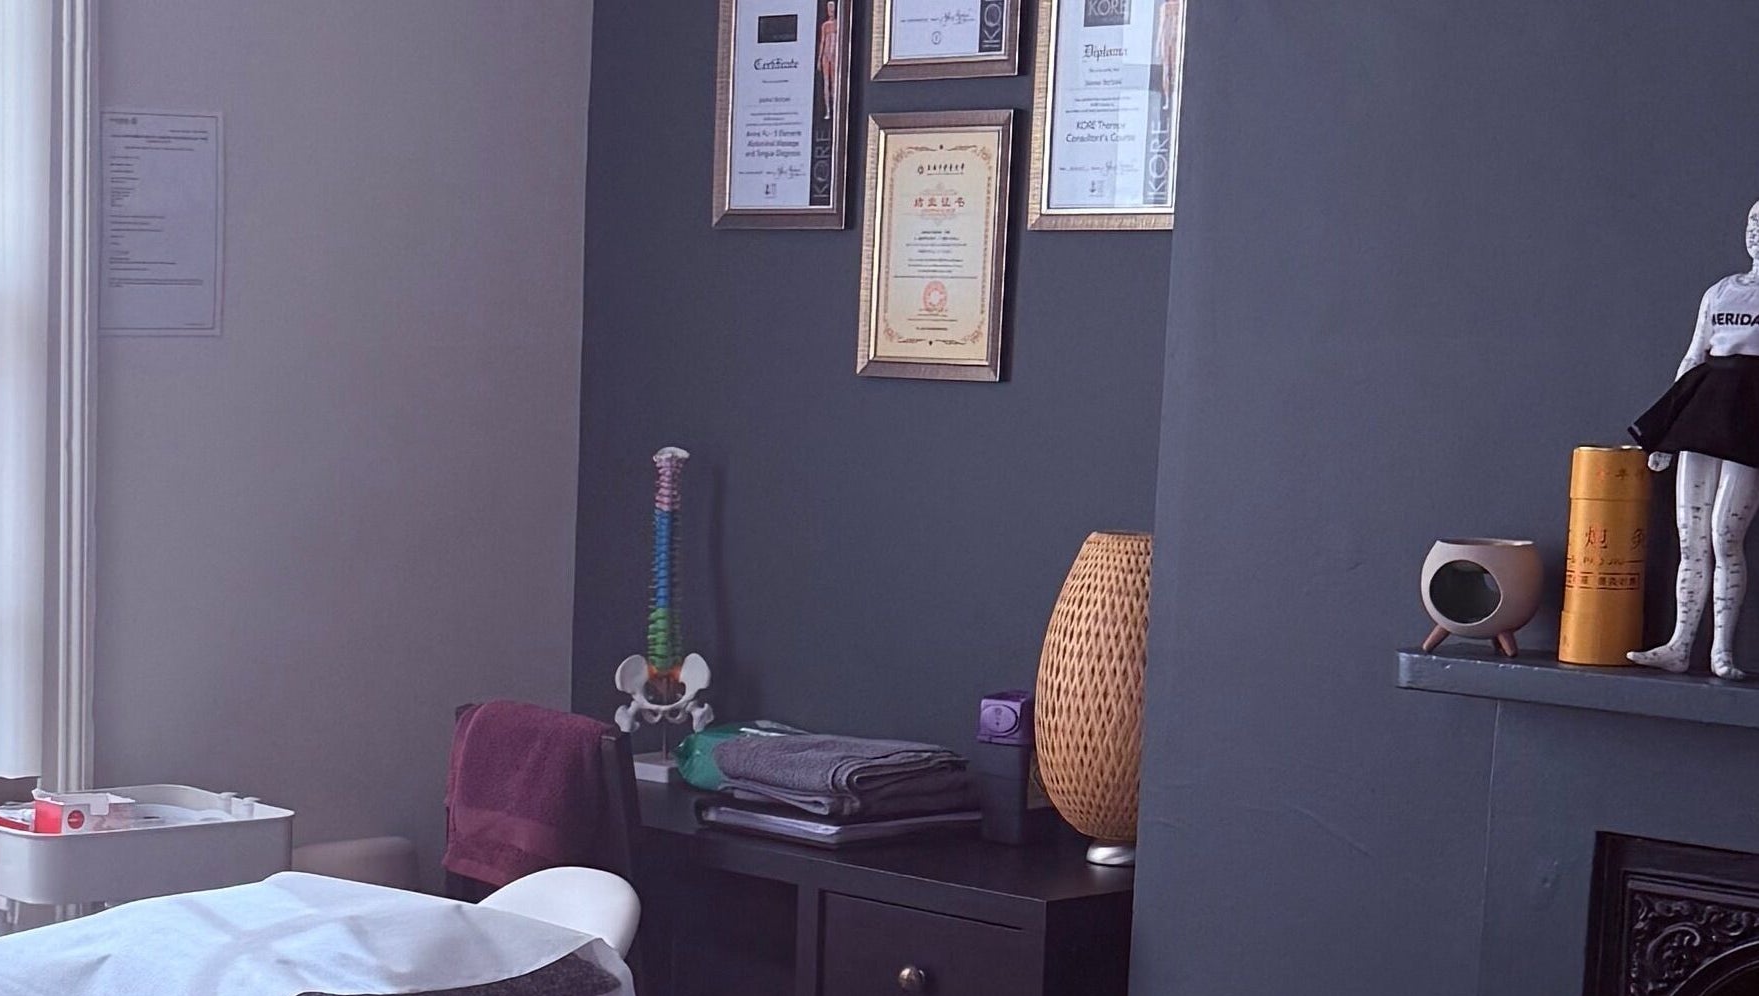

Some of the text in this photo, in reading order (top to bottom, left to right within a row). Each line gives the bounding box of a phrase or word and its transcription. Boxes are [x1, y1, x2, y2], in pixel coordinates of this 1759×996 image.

[753, 57, 799, 71] Certificate
[1082, 43, 1129, 62] Diploma
[812, 130, 832, 198] KORE
[1147, 117, 1170, 201] KORE
